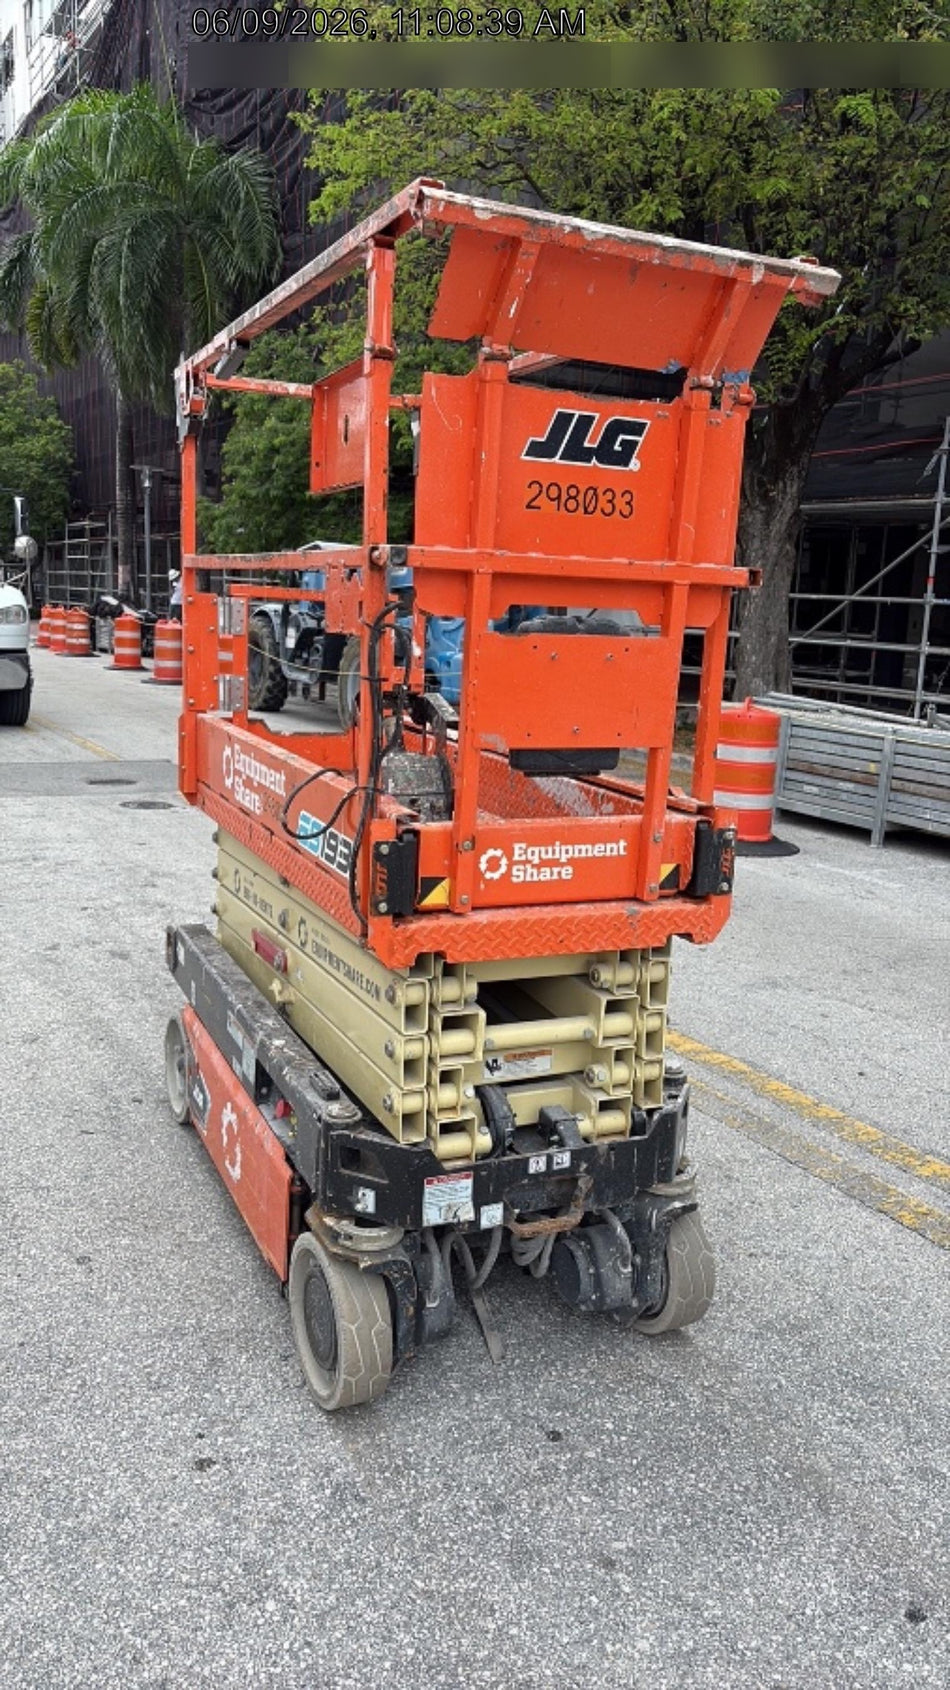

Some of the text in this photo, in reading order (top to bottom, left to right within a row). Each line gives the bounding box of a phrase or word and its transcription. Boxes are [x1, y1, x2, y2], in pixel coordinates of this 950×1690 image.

[521, 408, 651, 471] JLG
[525, 480, 634, 519] 298033
[234, 743, 286, 797] Equipment
[234, 775, 263, 815] Share
[512, 839, 627, 862] Equipment
[511, 863, 574, 883] Share
